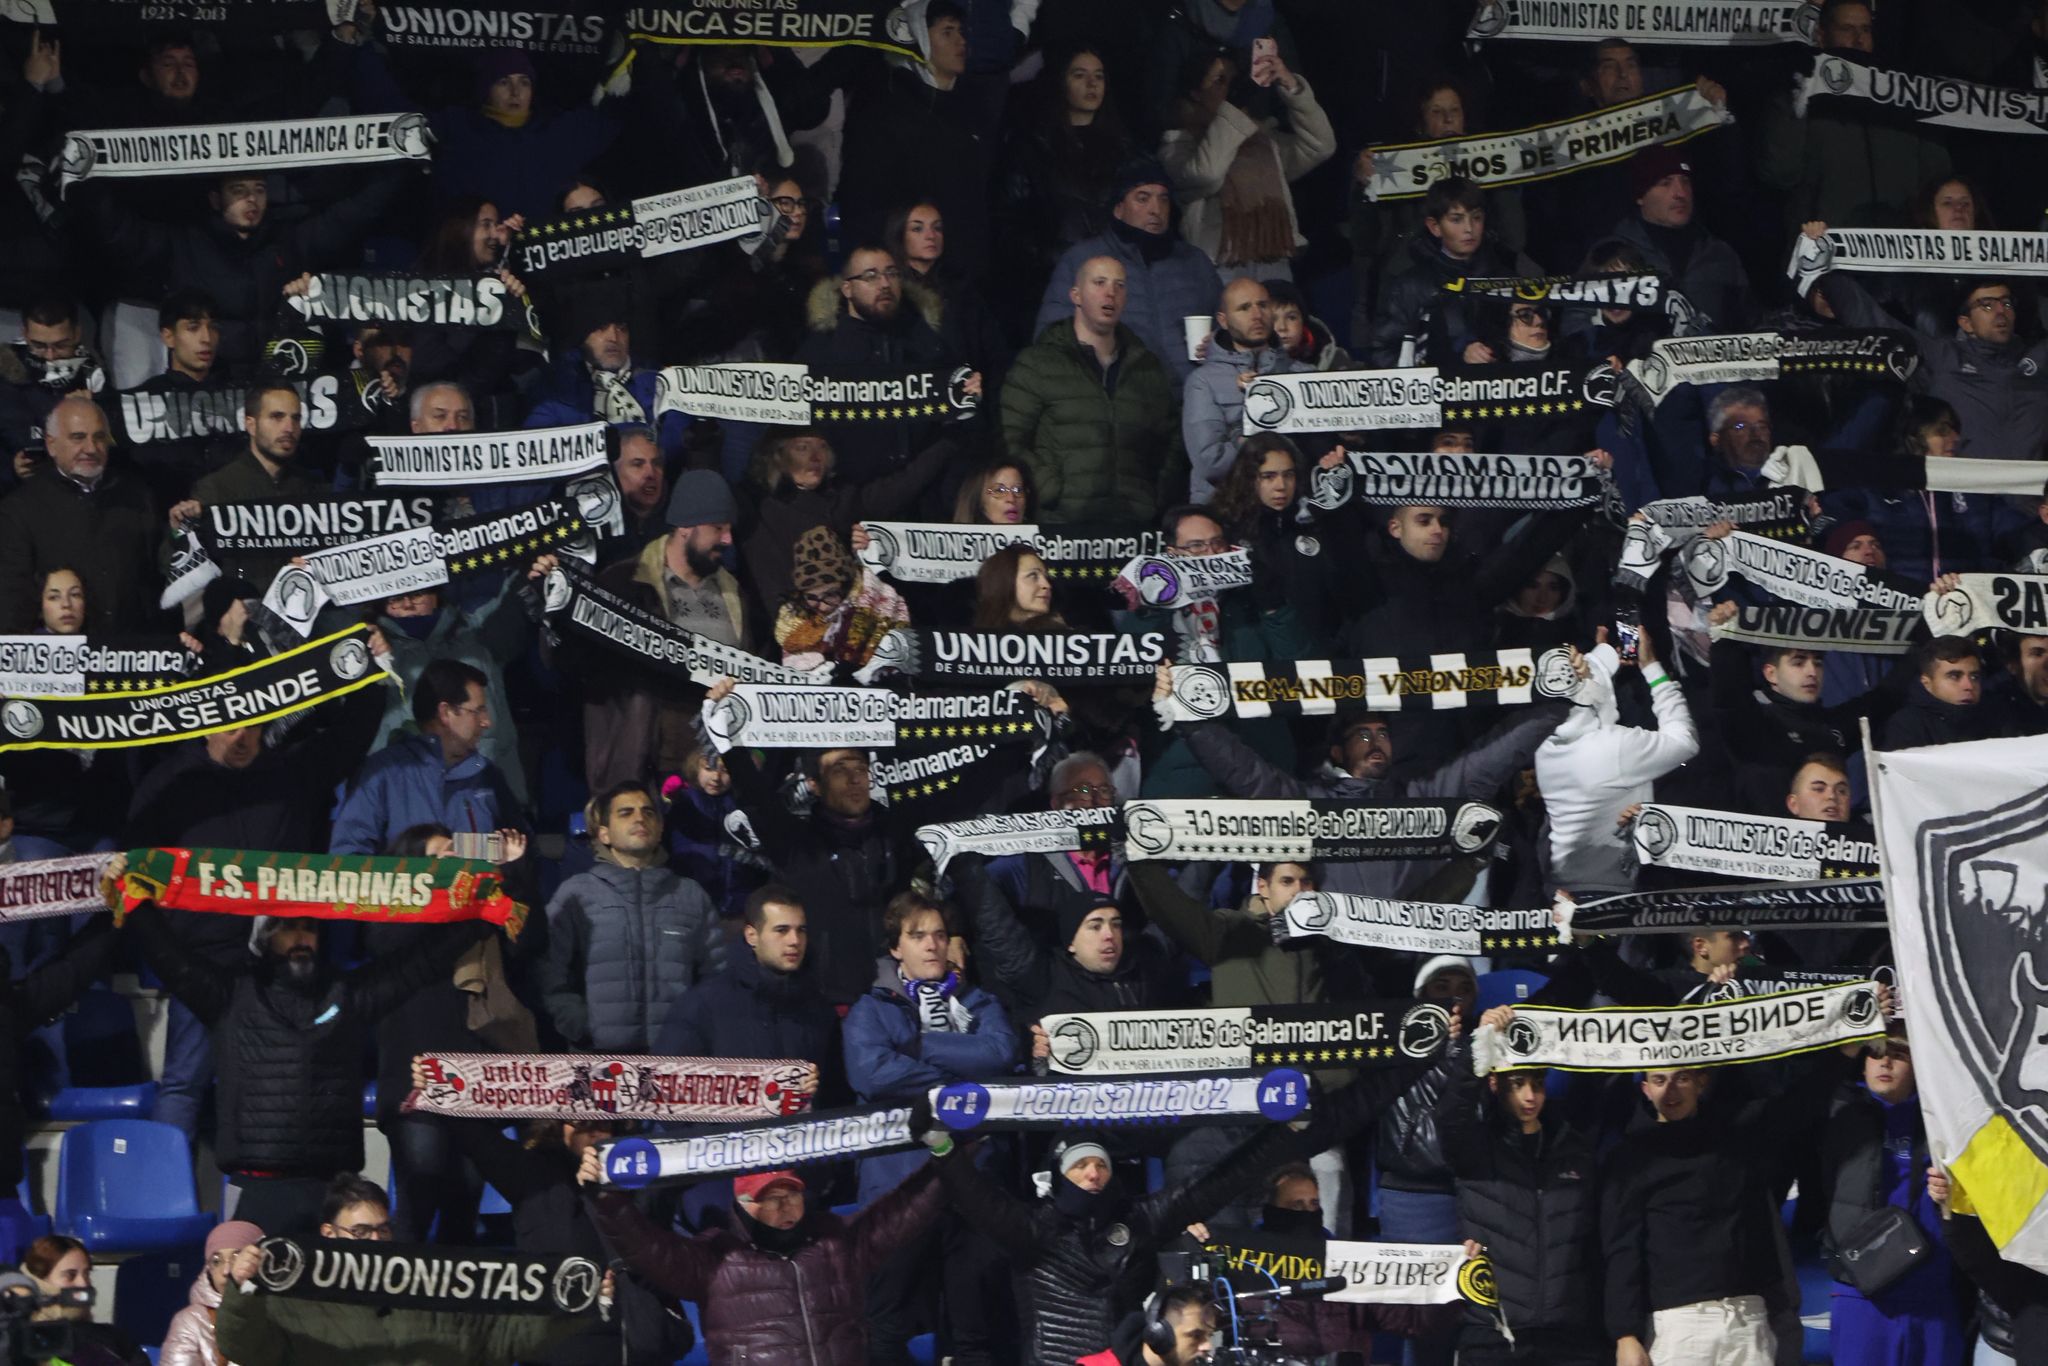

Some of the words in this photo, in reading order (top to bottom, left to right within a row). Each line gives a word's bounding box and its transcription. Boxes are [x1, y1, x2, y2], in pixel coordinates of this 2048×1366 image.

[140, 6, 176, 20] 1923
[192, 6, 227, 20] 2013
[380, 6, 604, 43] UNIONISTAS
[732, 13, 773, 35] SE
[780, 13, 874, 37] RINDE
[1519, 0, 1619, 30] UNIONISTAS
[1625, 4, 1646, 31] DE
[1652, 5, 1751, 33] SALAMANCA
[1757, 8, 1780, 35] CF
[386, 34, 402, 44] DE
[407, 34, 486, 48] SALAMANCA
[491, 40, 524, 49] CLUB
[107, 134, 211, 164] UNIONISTAS
[218, 132, 239, 158] DE
[246, 125, 348, 156] SALAMANCA
[355, 122, 376, 149] CF
[1520, 147, 1556, 171] DE
[646, 216, 668, 242] de
[671, 196, 762, 242] UNIONISTAS
[548, 222, 647, 264] Salamanca
[1845, 234, 1946, 261] UNIONISTAS
[1952, 236, 1973, 261] DE
[1664, 336, 1752, 366] UNIONISTAS
[1752, 337, 1774, 361] de
[1773, 335, 1862, 358] Salamanca
[677, 367, 777, 400] UNIONISTAS
[779, 376, 800, 400] de
[802, 374, 904, 402] Salamanca
[905, 372, 939, 400] C.F.
[1300, 379, 1404, 409] UNIONISTAS
[1409, 380, 1431, 405] de
[1433, 374, 1538, 402] Salamanca
[1541, 369, 1574, 397] C.F.
[383, 446, 483, 473] UNIONISTAS
[491, 442, 510, 469] DE
[210, 497, 434, 540] UNIONISTAS
[216, 537, 233, 548] DE
[237, 537, 321, 549] SALAMANCA
[324, 534, 358, 548] CLUB
[408, 537, 433, 565] de
[430, 508, 537, 559] Salamanca
[1033, 532, 1138, 561] Salamanca
[1732, 536, 1830, 590] UNIONISTAS
[1830, 568, 1852, 596] de
[51, 642, 77, 674] de
[77, 643, 184, 673] Salamanca
[933, 632, 1164, 665] UNIONISTAS
[934, 662, 952, 674] DE
[957, 664, 1042, 677] SALAMANCA
[1047, 665, 1082, 677] CLUB
[1087, 665, 1105, 676] DE
[57, 713, 175, 741] NUNCA
[179, 701, 224, 731] SE
[227, 668, 322, 721] RINDE
[130, 681, 237, 713] UNIONISTAS
[757, 692, 862, 723] UNIONISTAS
[863, 693, 886, 723] de
[886, 691, 990, 722] Salamanca
[991, 689, 1025, 717] C.F.
[1234, 675, 1367, 704] KOMANDO
[872, 745, 976, 787] Salamanca
[946, 813, 1041, 838] UNIONISTAS
[1687, 815, 1789, 856] UNIONISTAS
[1790, 831, 1816, 859] de
[199, 863, 251, 899] F.S.
[257, 865, 434, 908] PARADINAS
[1344, 894, 1446, 929] UNIONISTAS
[1449, 908, 1472, 932] de
[1108, 1021, 1214, 1051] UNIONISTAS
[1218, 1020, 1242, 1047] de
[1242, 1017, 1353, 1046] Salamanca
[1354, 1012, 1390, 1041] C.F.
[483, 1064, 549, 1083] unión
[471, 1084, 568, 1107] deportiva
[1014, 1082, 1091, 1119] Peña
[1093, 1080, 1193, 1117] Salida
[1192, 1077, 1231, 1111] 82
[687, 1134, 766, 1172] Peña
[768, 1105, 865, 1166] Salida
[865, 1111, 910, 1150] 82
[311, 1249, 547, 1303] UNIONISTAS
